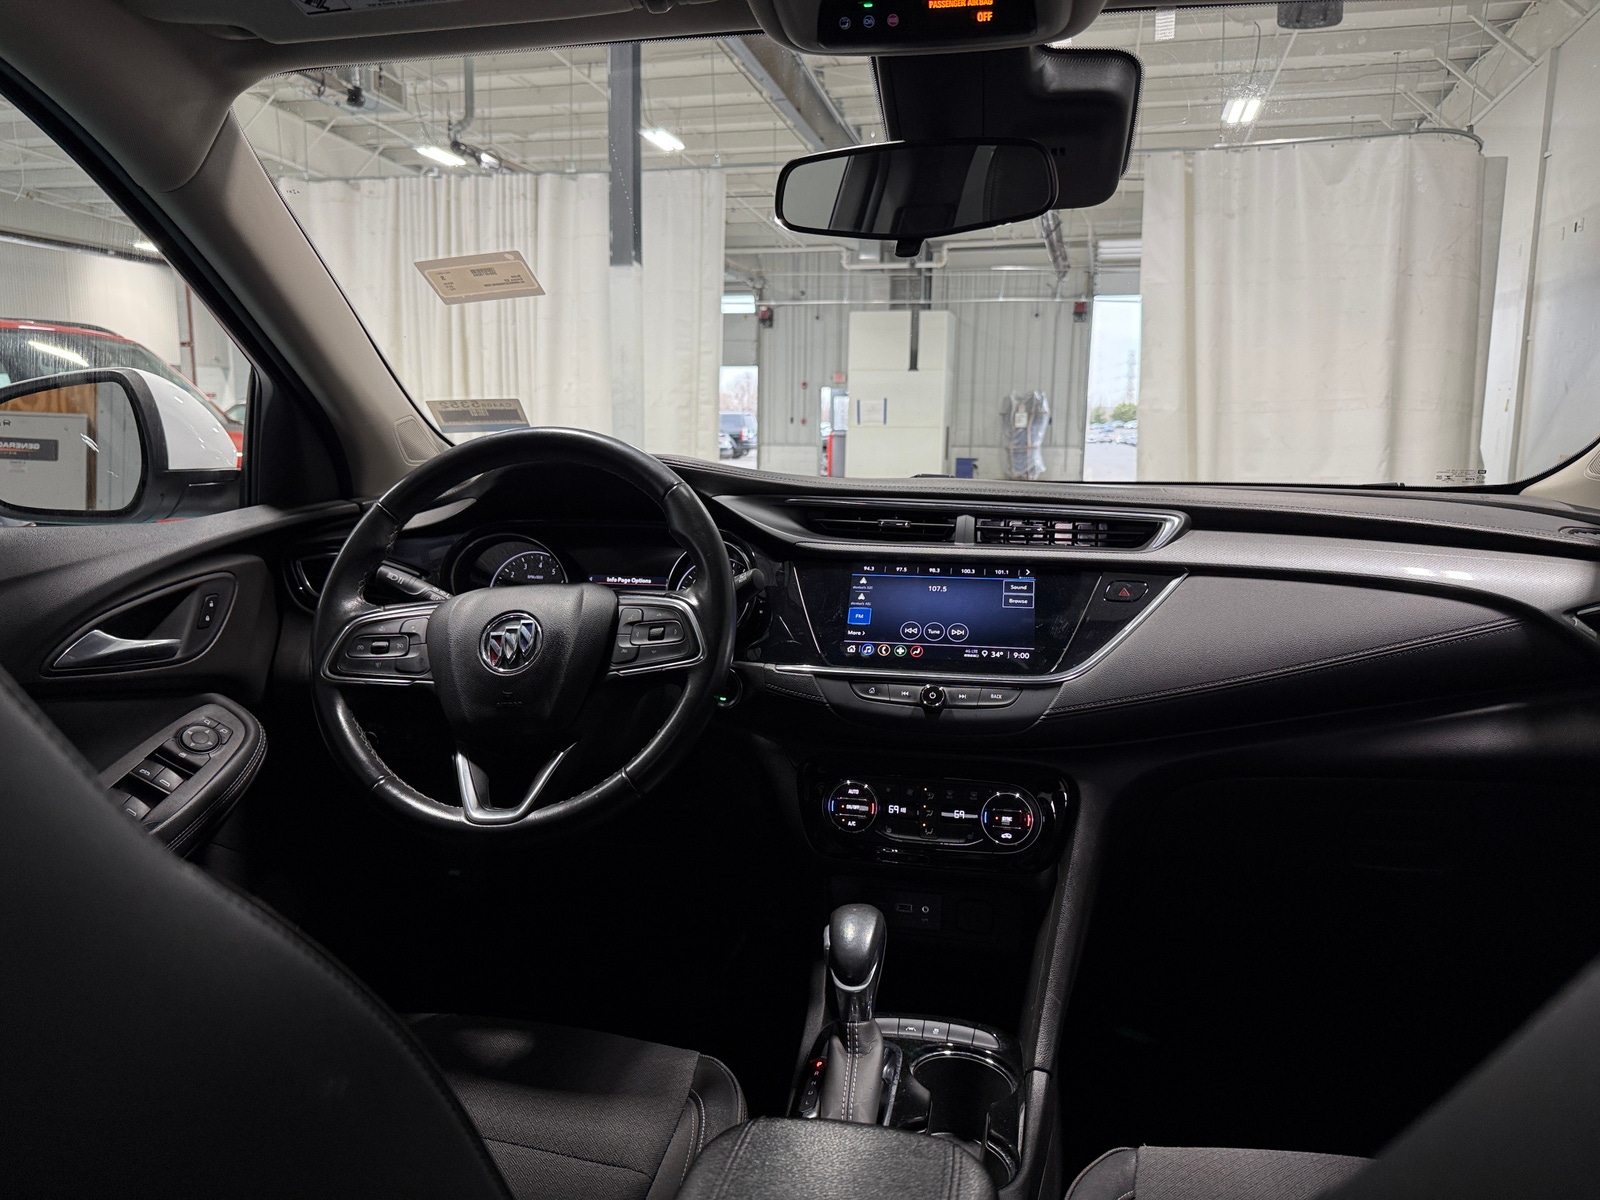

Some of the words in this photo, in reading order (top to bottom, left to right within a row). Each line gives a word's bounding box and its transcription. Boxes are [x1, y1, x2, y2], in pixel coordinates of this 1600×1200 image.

[928, 0, 966, 8] PASSENGER
[976, 12, 993, 22] OFF
[888, 805, 900, 814] 69
[954, 810, 965, 819] 69
